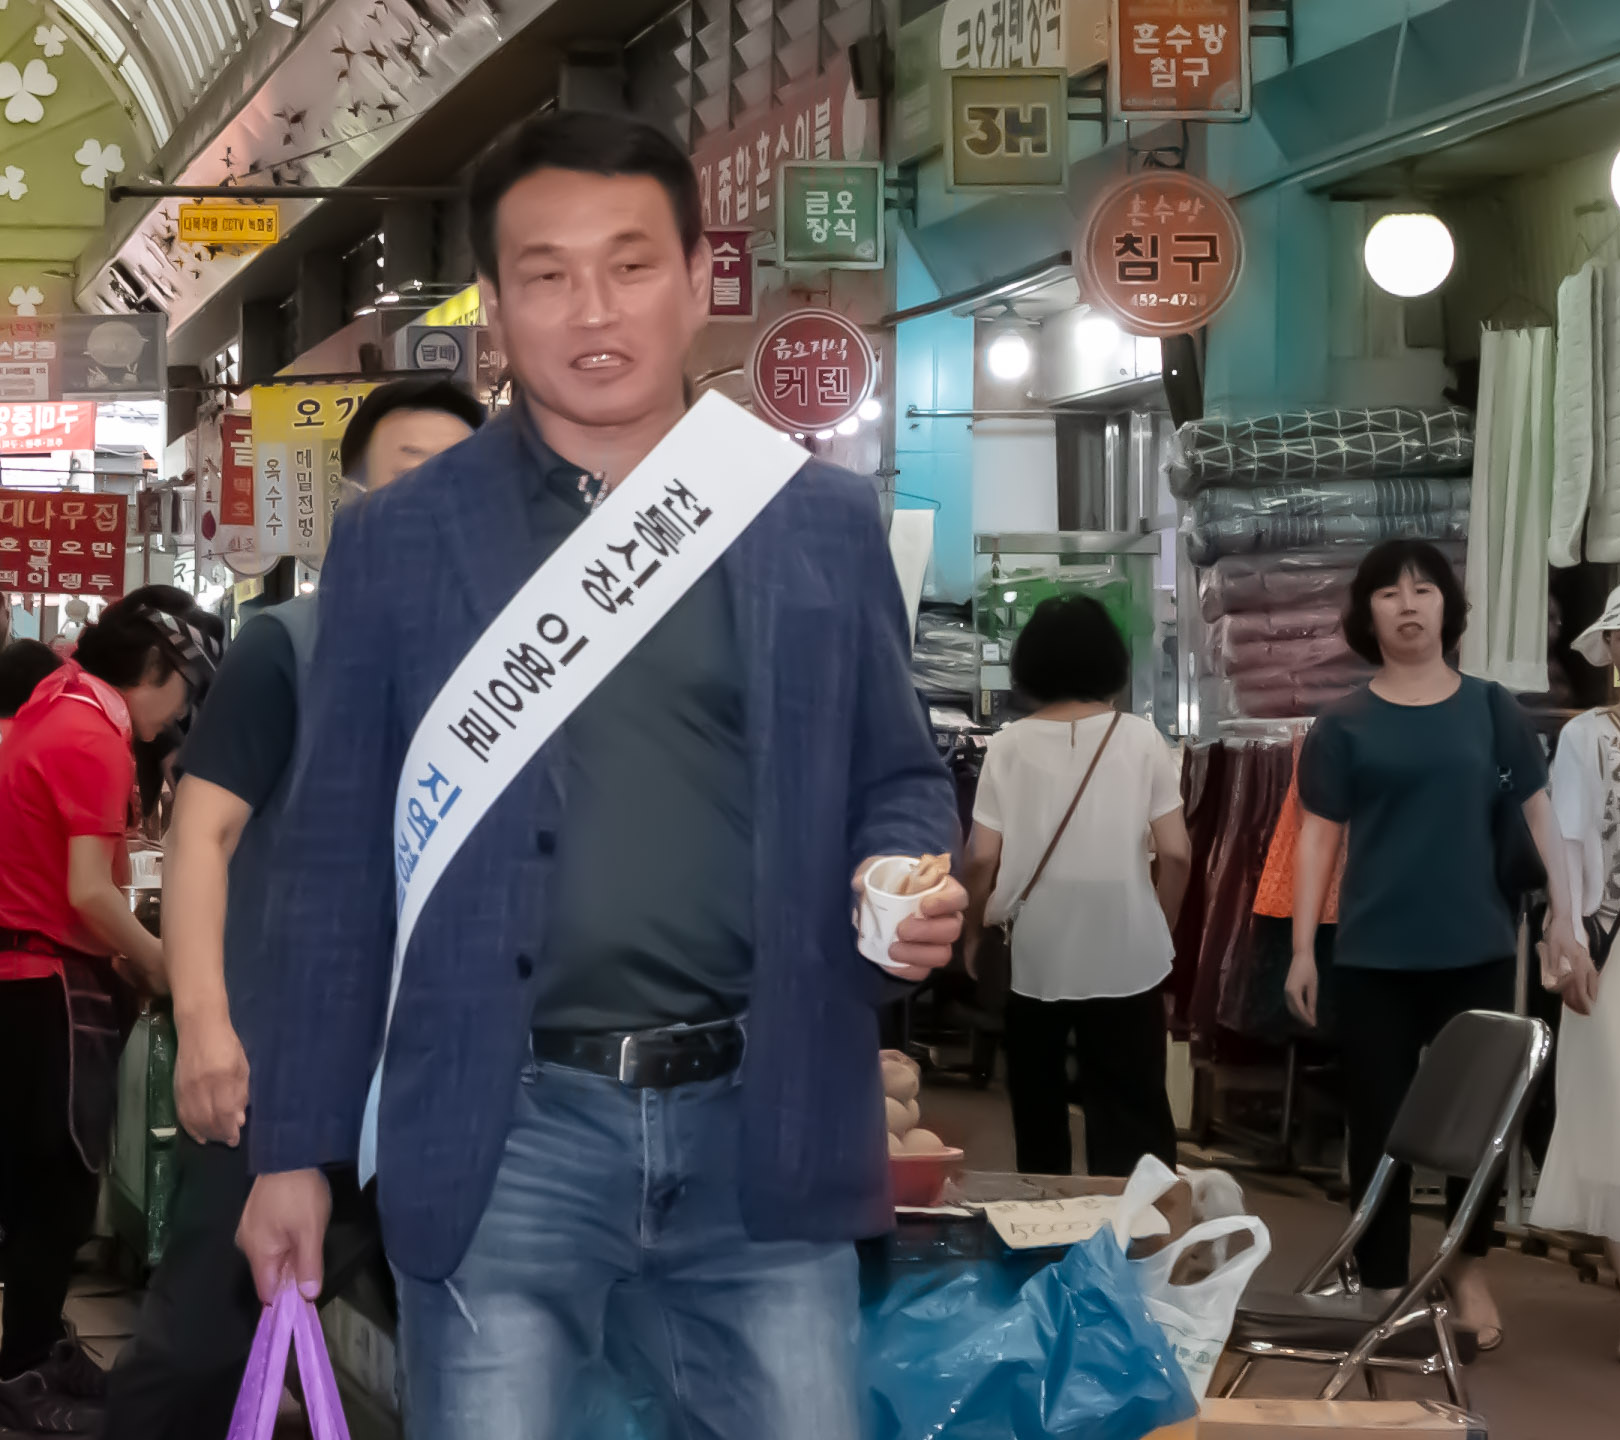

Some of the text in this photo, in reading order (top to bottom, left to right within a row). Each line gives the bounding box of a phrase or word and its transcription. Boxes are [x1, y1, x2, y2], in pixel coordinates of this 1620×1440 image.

[1133, 22, 1227, 54] 혼수방
[1150, 59, 1209, 87] 침구
[963, 104, 1048, 155] 3H
[806, 190, 857, 215] 금오
[806, 217, 857, 243] 장식
[1114, 232, 1221, 284] 침구
[774, 367, 851, 406] 커텐
[264, 459, 283, 536] 옥수수
[579, 479, 713, 614] 전통시장
[397, 762, 463, 910] 지역경
